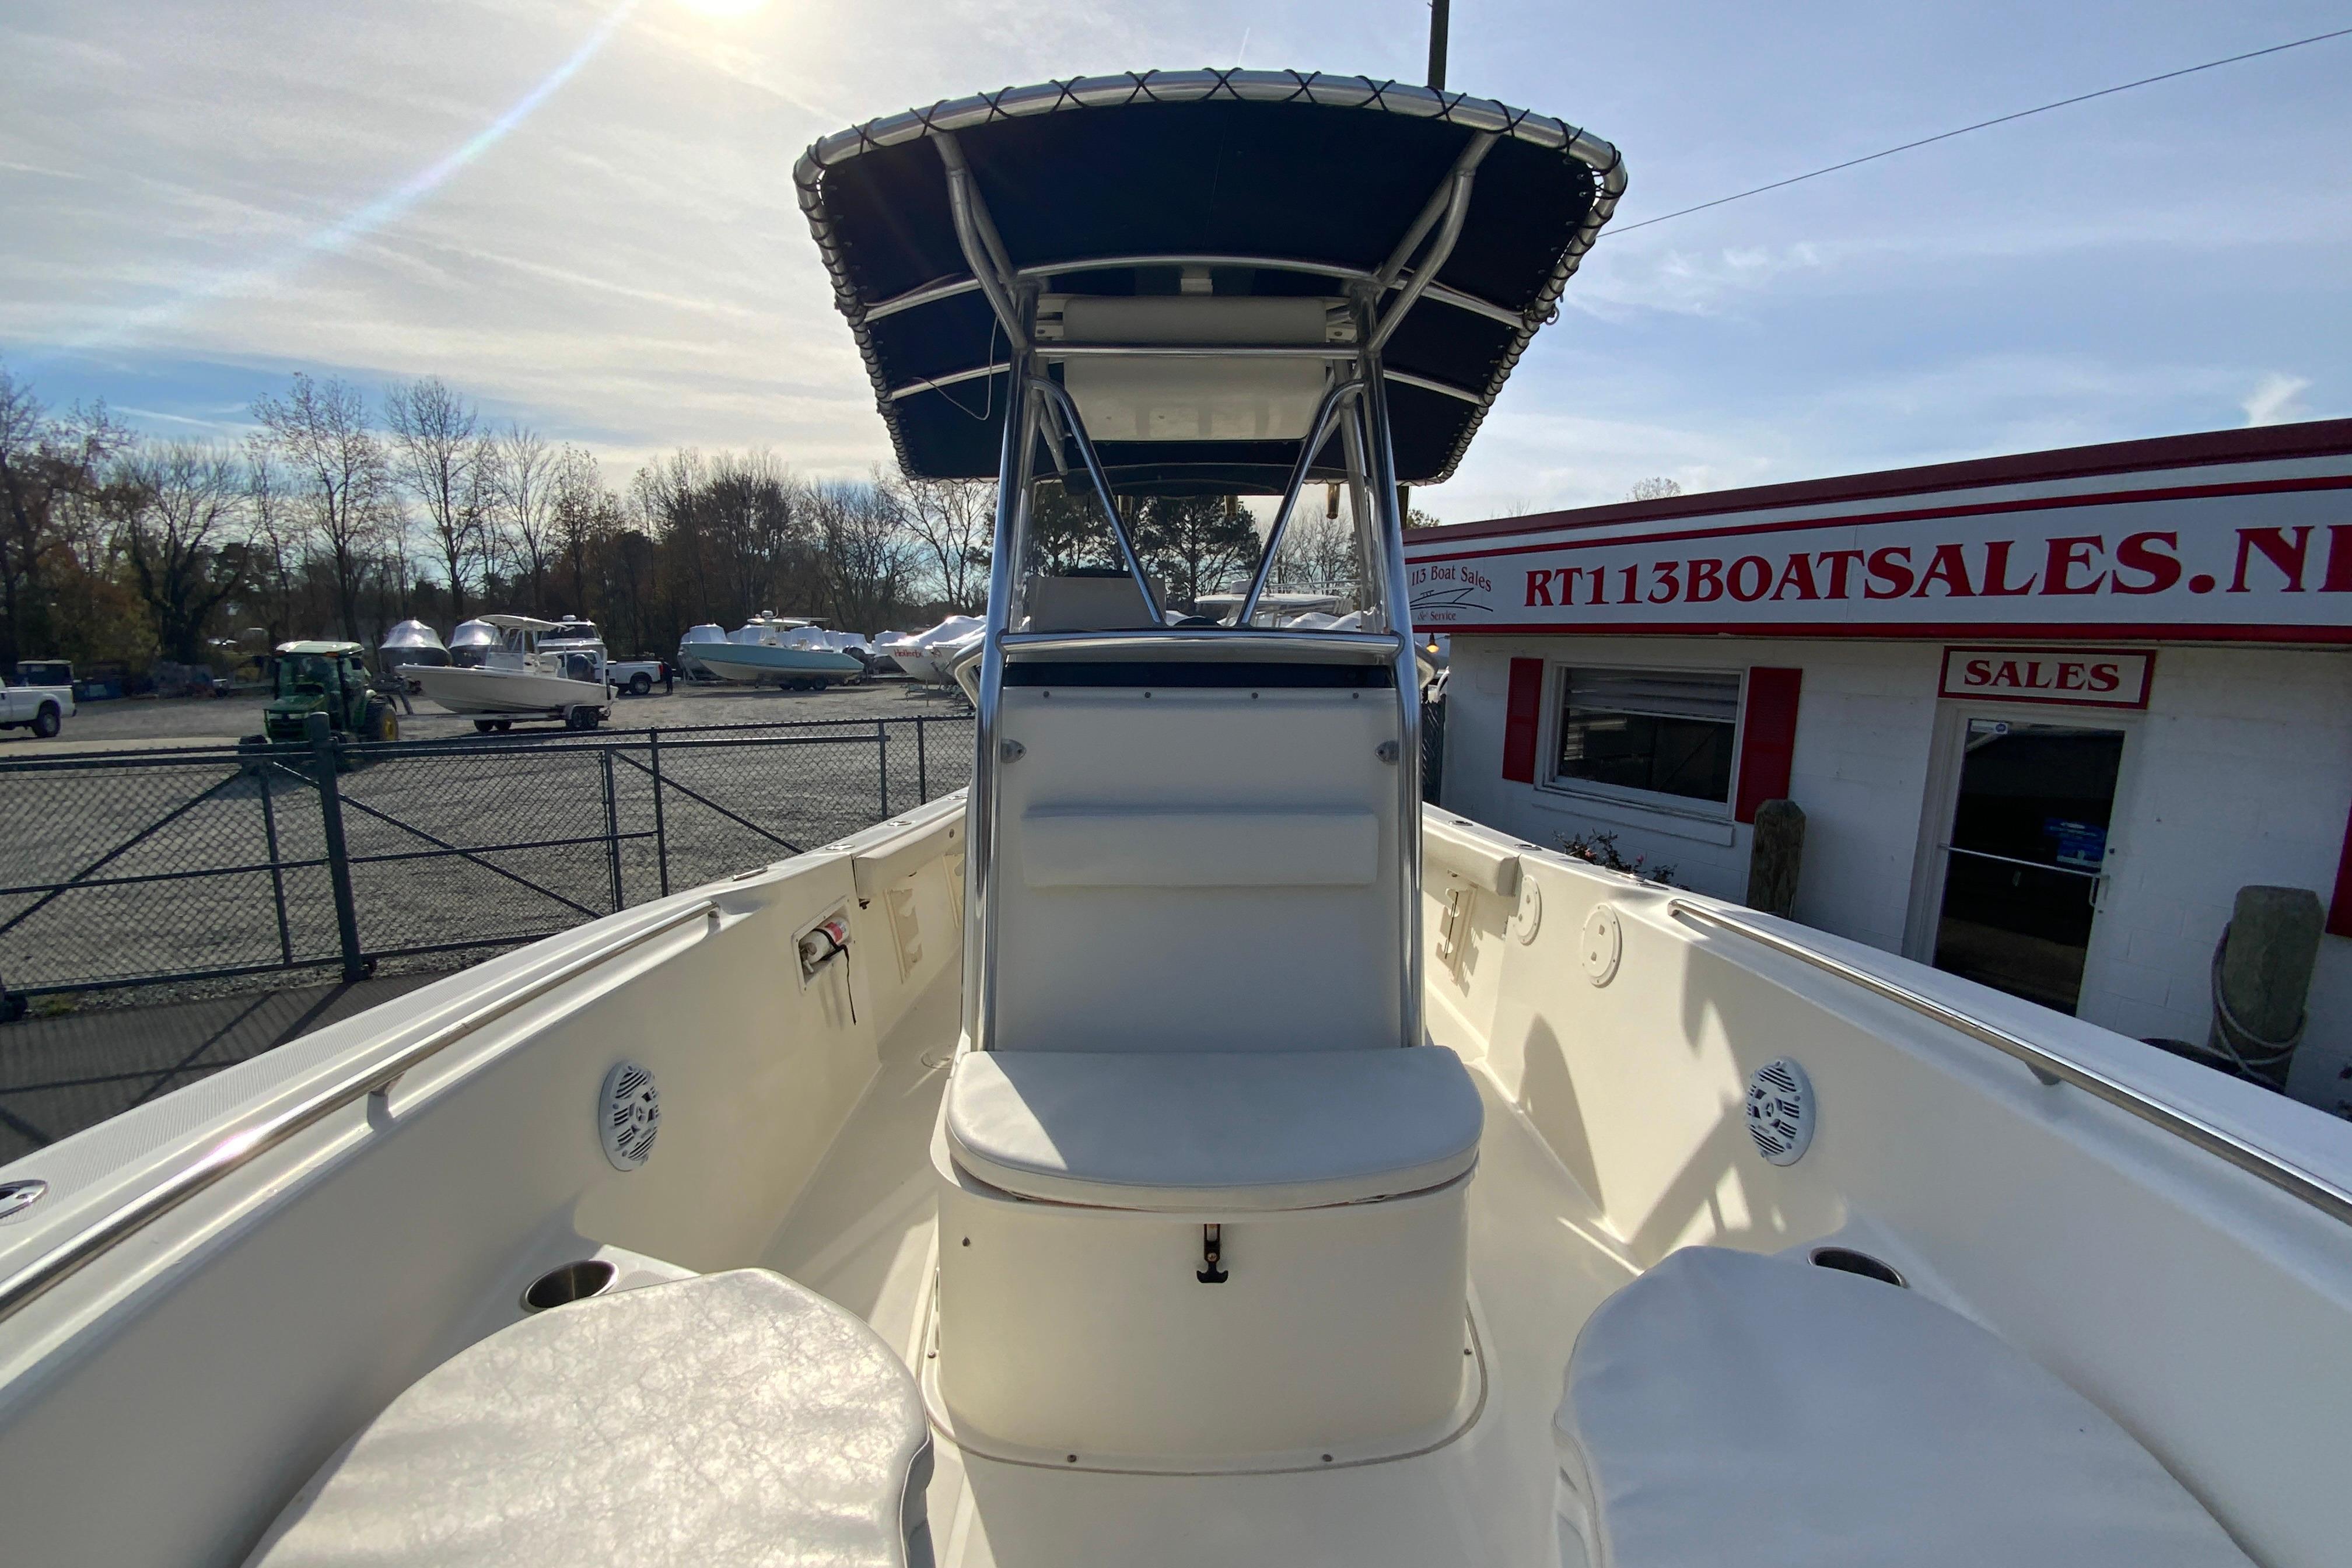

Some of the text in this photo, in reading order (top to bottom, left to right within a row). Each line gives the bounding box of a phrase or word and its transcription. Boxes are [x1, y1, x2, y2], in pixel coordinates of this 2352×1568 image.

[1412, 565, 1492, 592] 113 Boat Sales
[1430, 610, 1457, 621] Service
[1964, 659, 2120, 692] SALES
